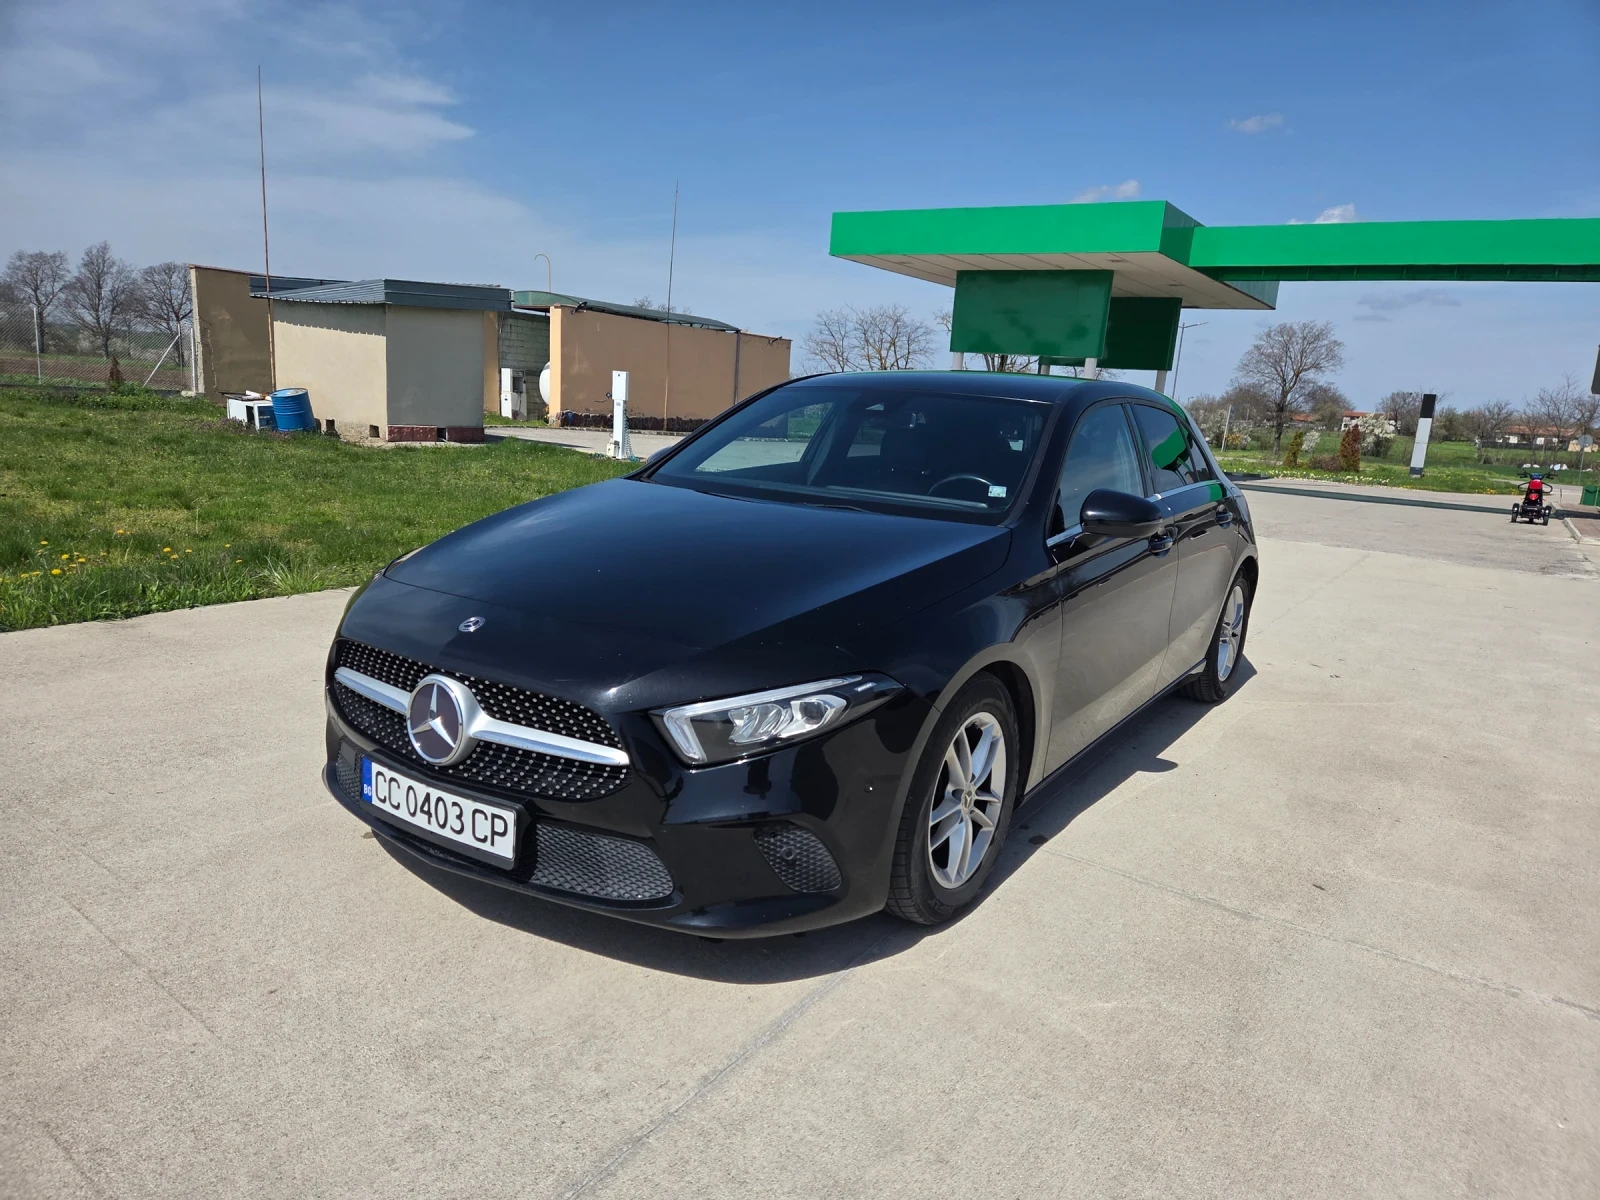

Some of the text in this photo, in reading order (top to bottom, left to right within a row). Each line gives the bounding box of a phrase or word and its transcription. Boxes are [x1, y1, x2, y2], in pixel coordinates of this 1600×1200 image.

[363, 783, 372, 797] BG
[375, 771, 508, 847] CC 0403 CP
